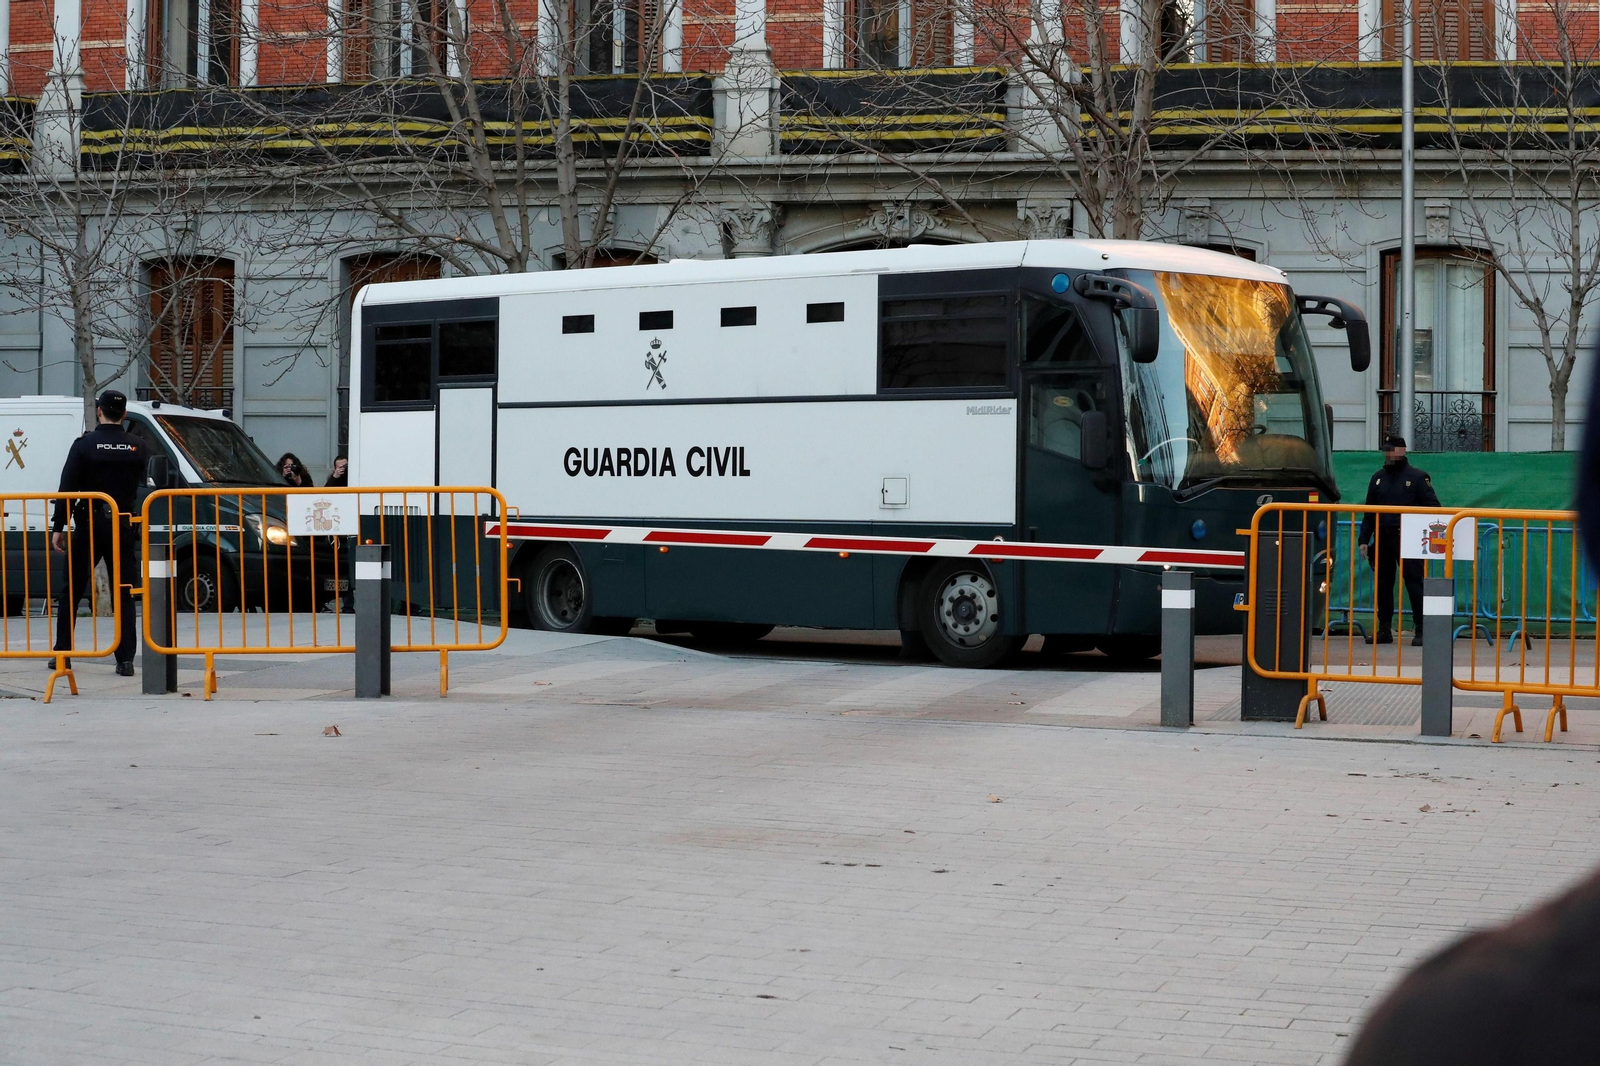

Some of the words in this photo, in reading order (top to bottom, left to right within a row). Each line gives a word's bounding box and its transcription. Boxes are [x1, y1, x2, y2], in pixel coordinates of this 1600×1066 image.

[966, 405, 1012, 415] MidiRider
[563, 446, 677, 477] GUARDIA
[686, 446, 751, 477] CIVIL
